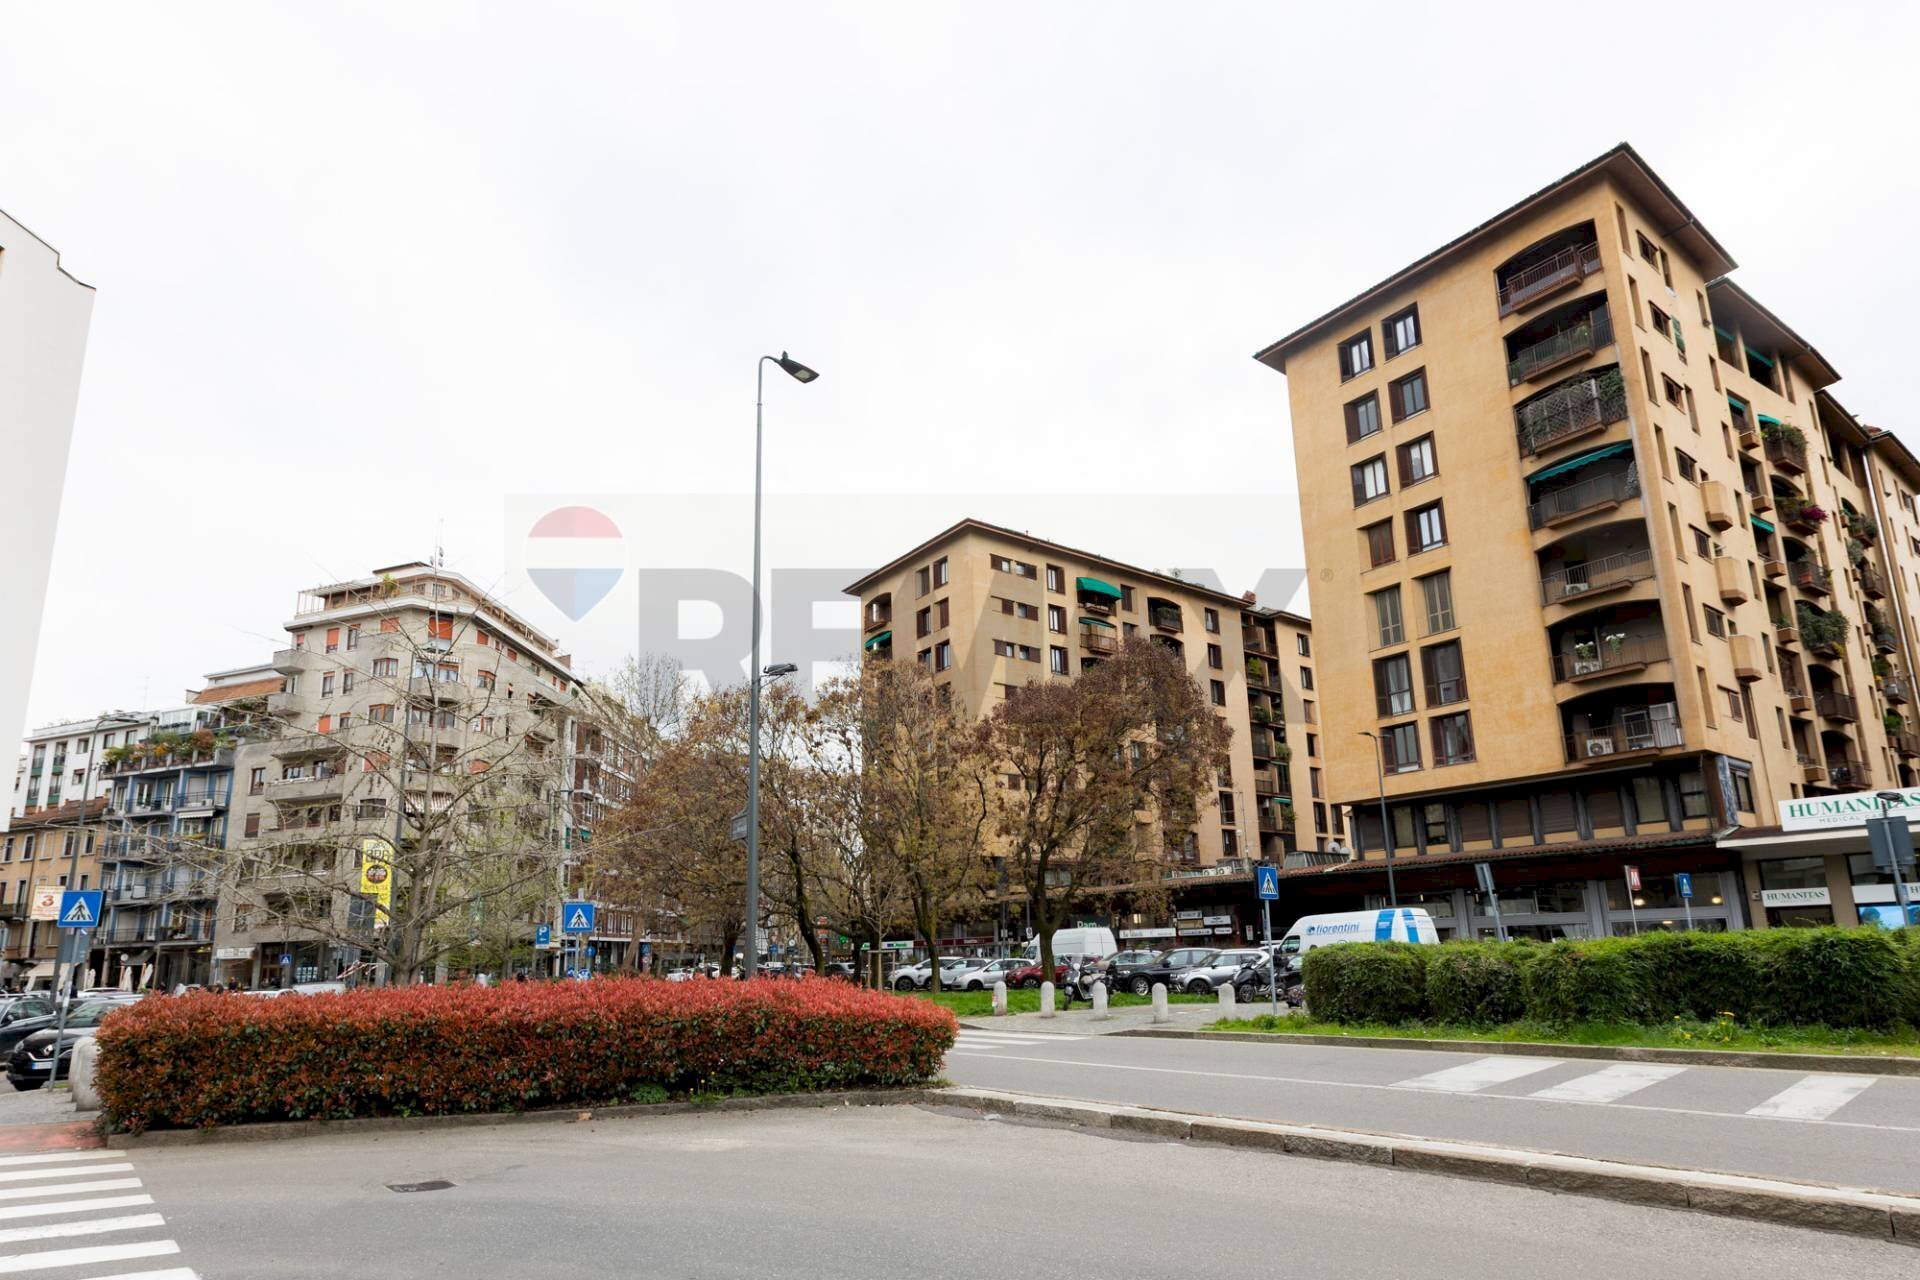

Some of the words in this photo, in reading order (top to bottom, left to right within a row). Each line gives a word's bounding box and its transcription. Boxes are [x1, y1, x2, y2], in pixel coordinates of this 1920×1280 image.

[1819, 815, 1861, 823] MEDICAL
[1766, 890, 1825, 901] HUMANITAS
[1316, 922, 1360, 935] fiorentini
